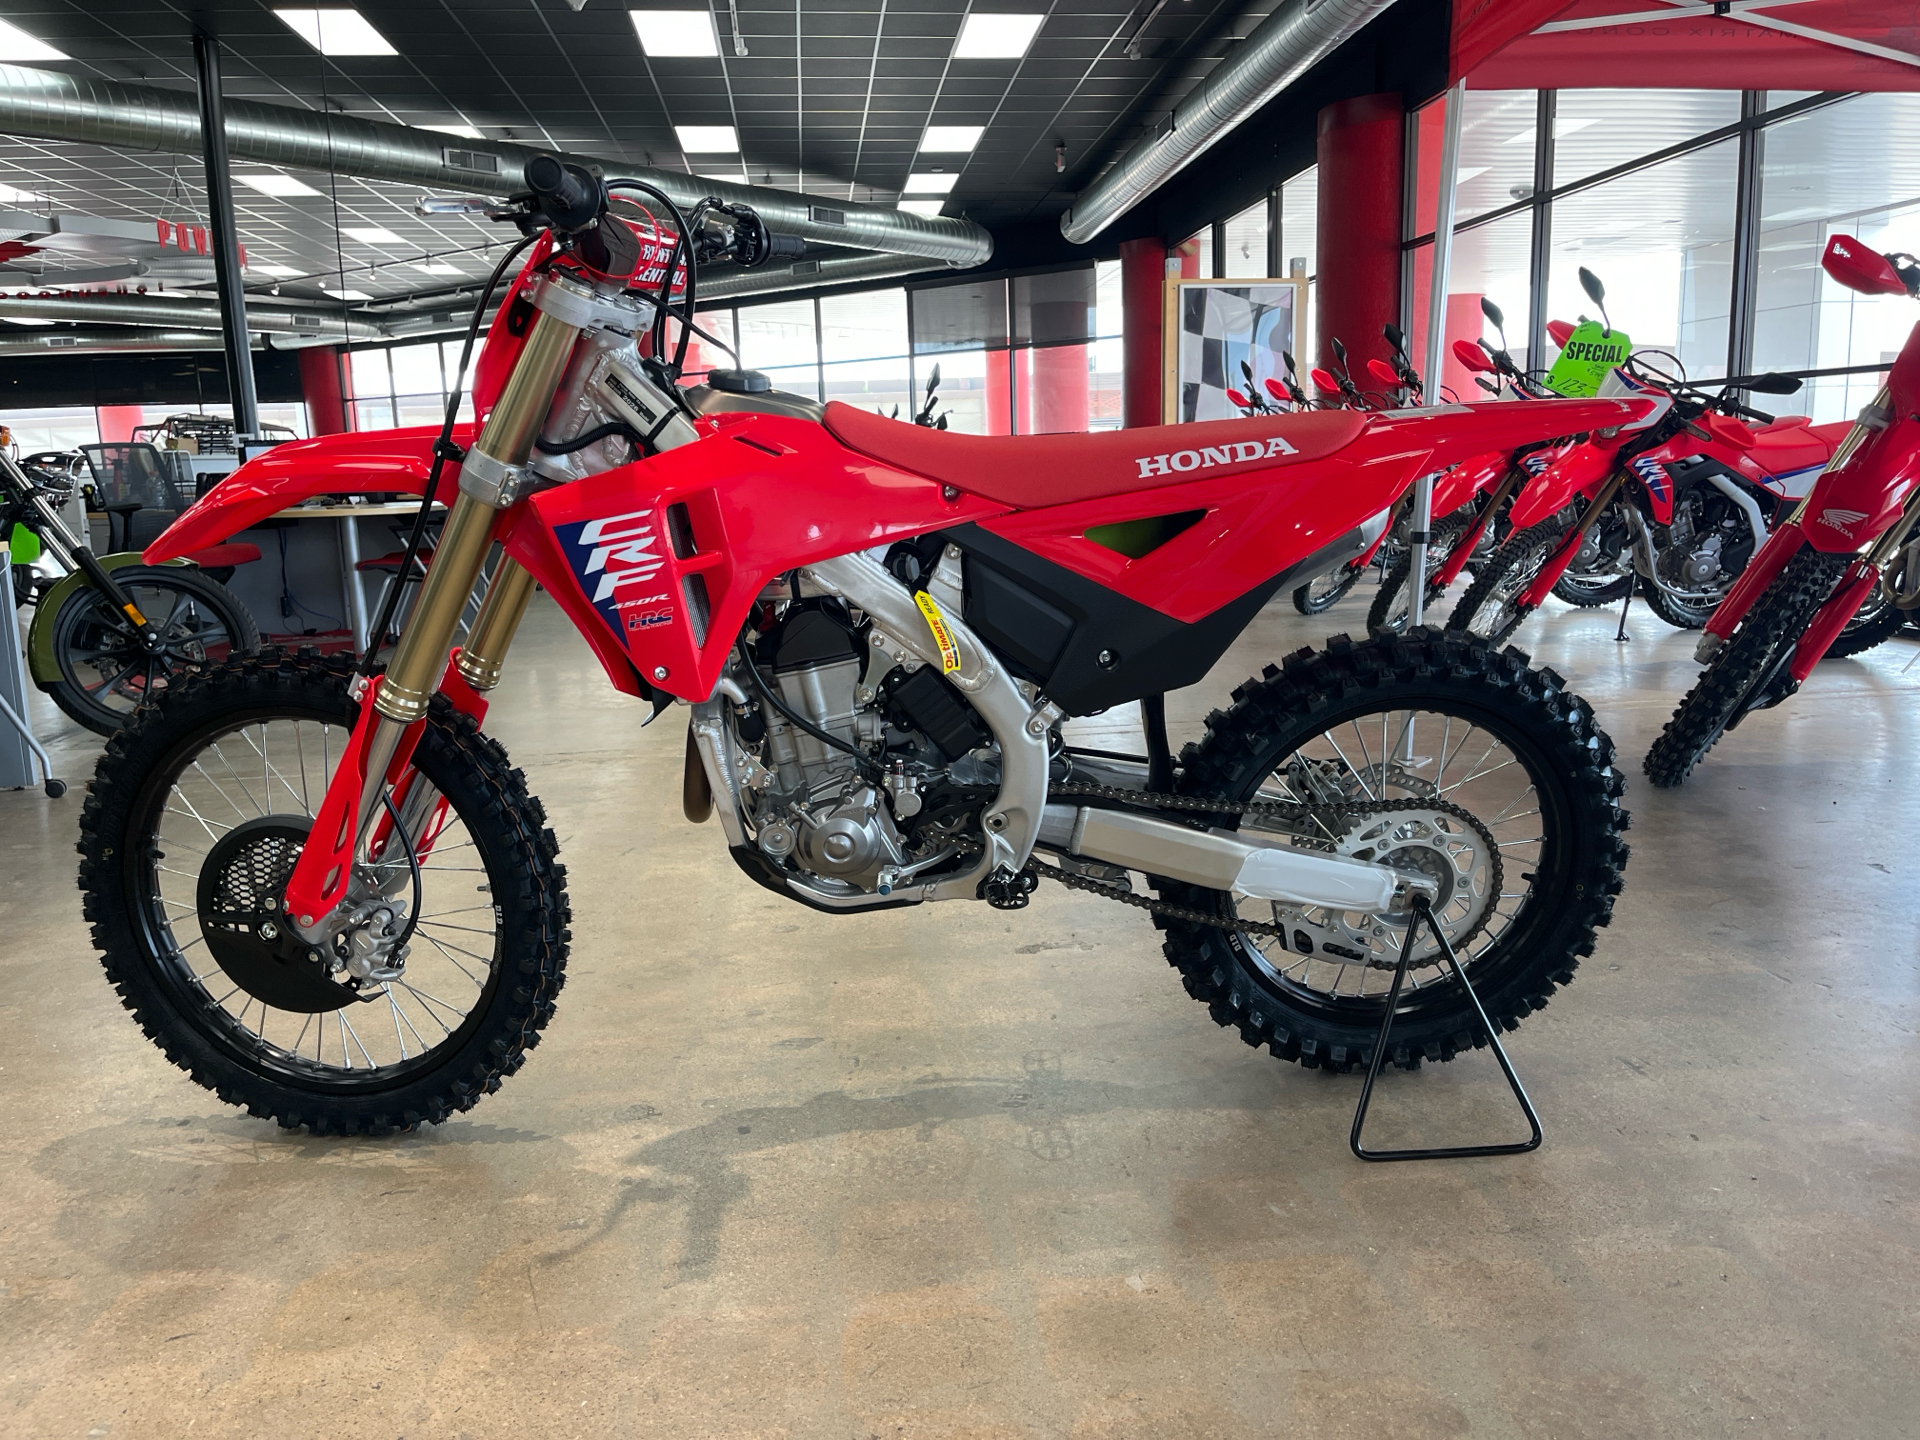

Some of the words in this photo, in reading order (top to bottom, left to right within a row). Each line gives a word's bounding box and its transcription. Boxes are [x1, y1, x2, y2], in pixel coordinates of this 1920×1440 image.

[1566, 341, 1623, 363] SPECIAL
[1135, 437, 1299, 478] HONDA
[1816, 517, 1854, 540] HONDA
[578, 509, 665, 604] CRF
[608, 593, 670, 610] 450R
[919, 594, 934, 615] READY
[628, 606, 674, 630] HRC
